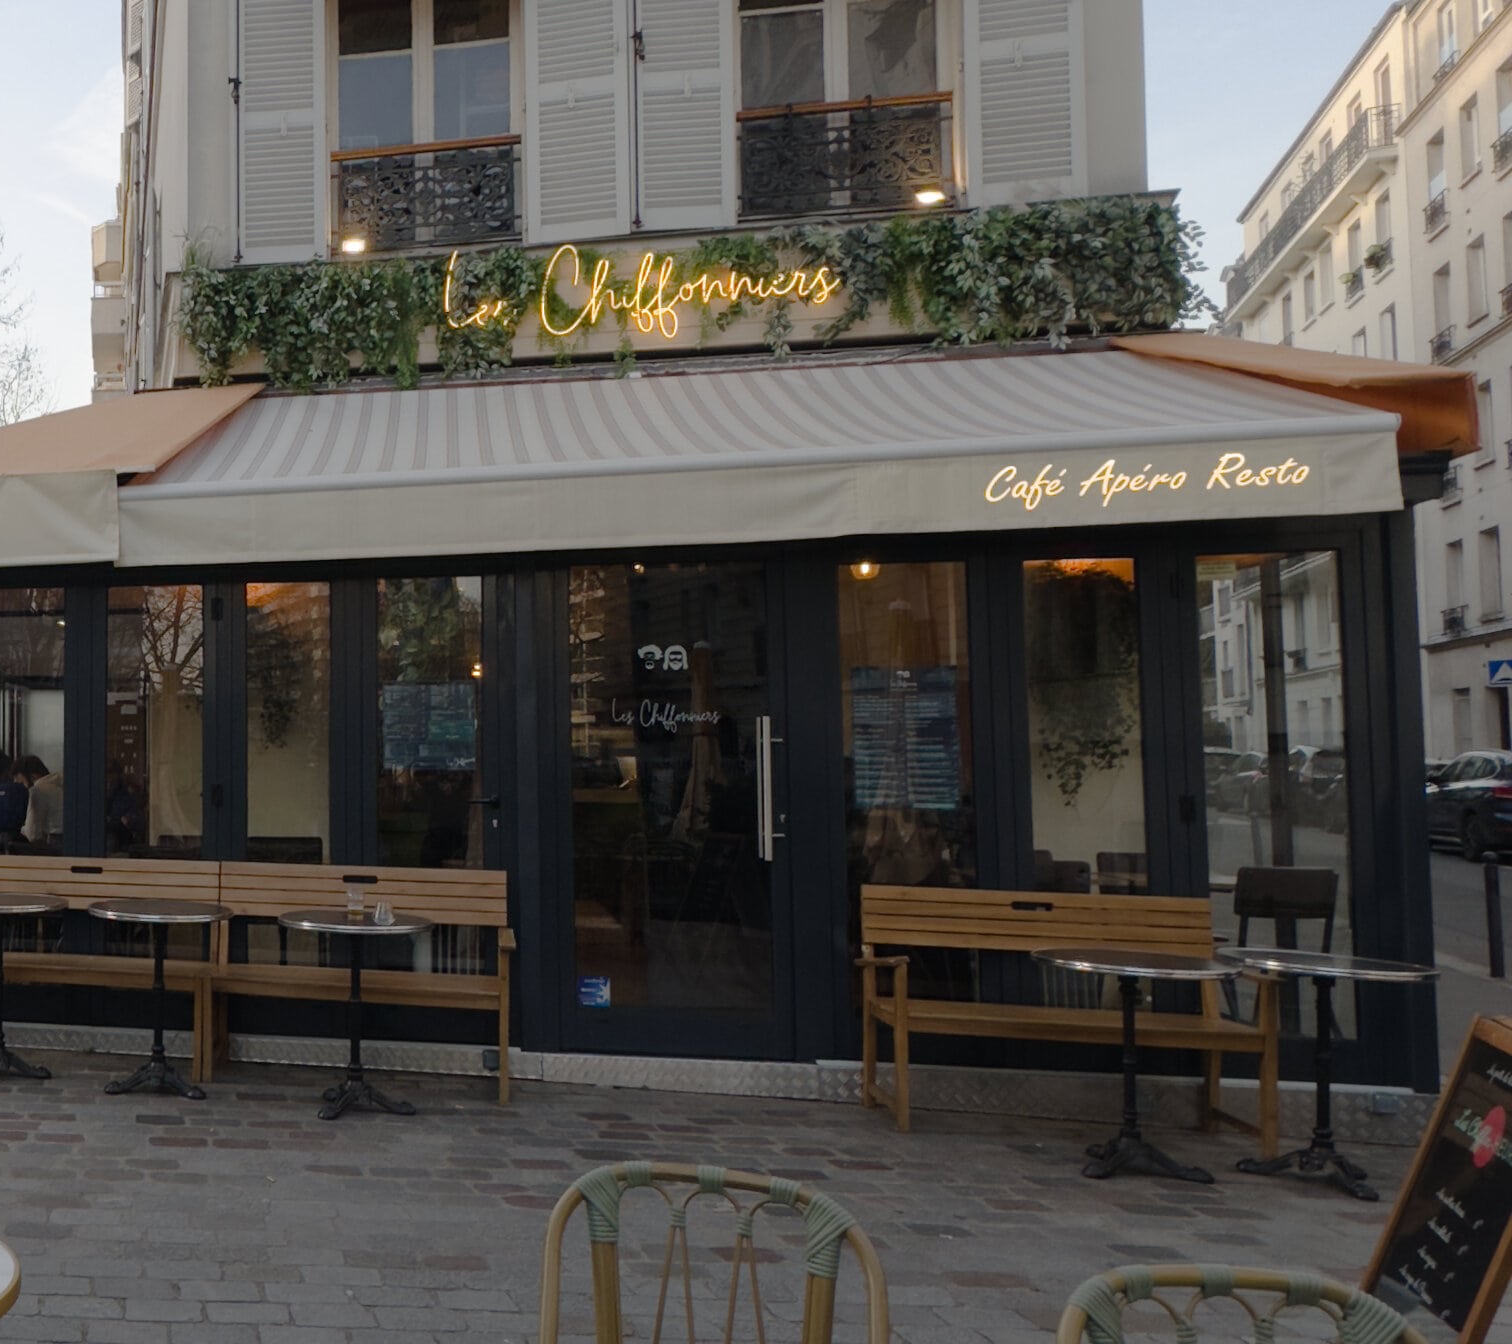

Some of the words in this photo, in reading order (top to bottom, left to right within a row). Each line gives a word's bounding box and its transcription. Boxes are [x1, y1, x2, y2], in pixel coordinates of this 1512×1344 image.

[984, 464, 1068, 511] Café
[1078, 458, 1188, 508] Apéro
[1206, 452, 1311, 491] Resto
[611, 697, 635, 724] Les
